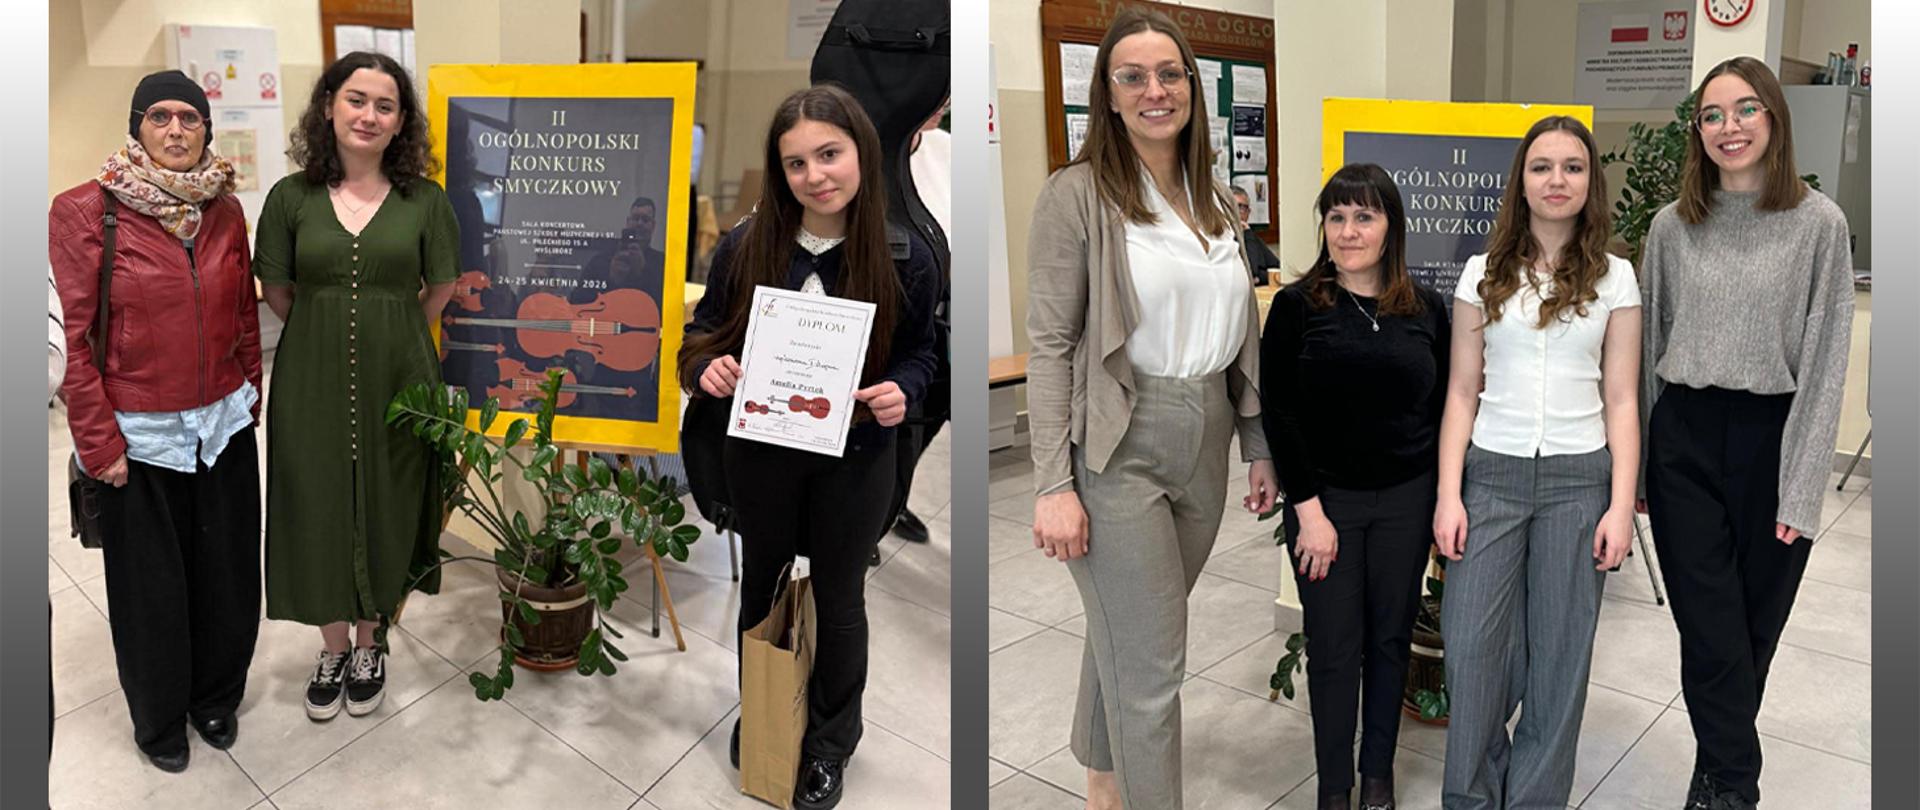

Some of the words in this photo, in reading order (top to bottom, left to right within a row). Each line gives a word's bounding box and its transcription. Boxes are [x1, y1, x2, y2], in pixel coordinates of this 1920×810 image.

[552, 110, 566, 126] II
[479, 129, 640, 150] OGÓLNOPOLSKI
[510, 155, 605, 172] KONKURS
[1453, 149, 1466, 165] II
[1386, 166, 1507, 189] GÓLNOPOL
[494, 178, 621, 196] SMYCZKOWY
[540, 221, 585, 229] KONCERTOWA
[1406, 217, 1497, 235] MYCZKO
[498, 275, 527, 285] 24-25
[530, 277, 578, 287] KWIETNIA
[583, 279, 608, 289] 2026
